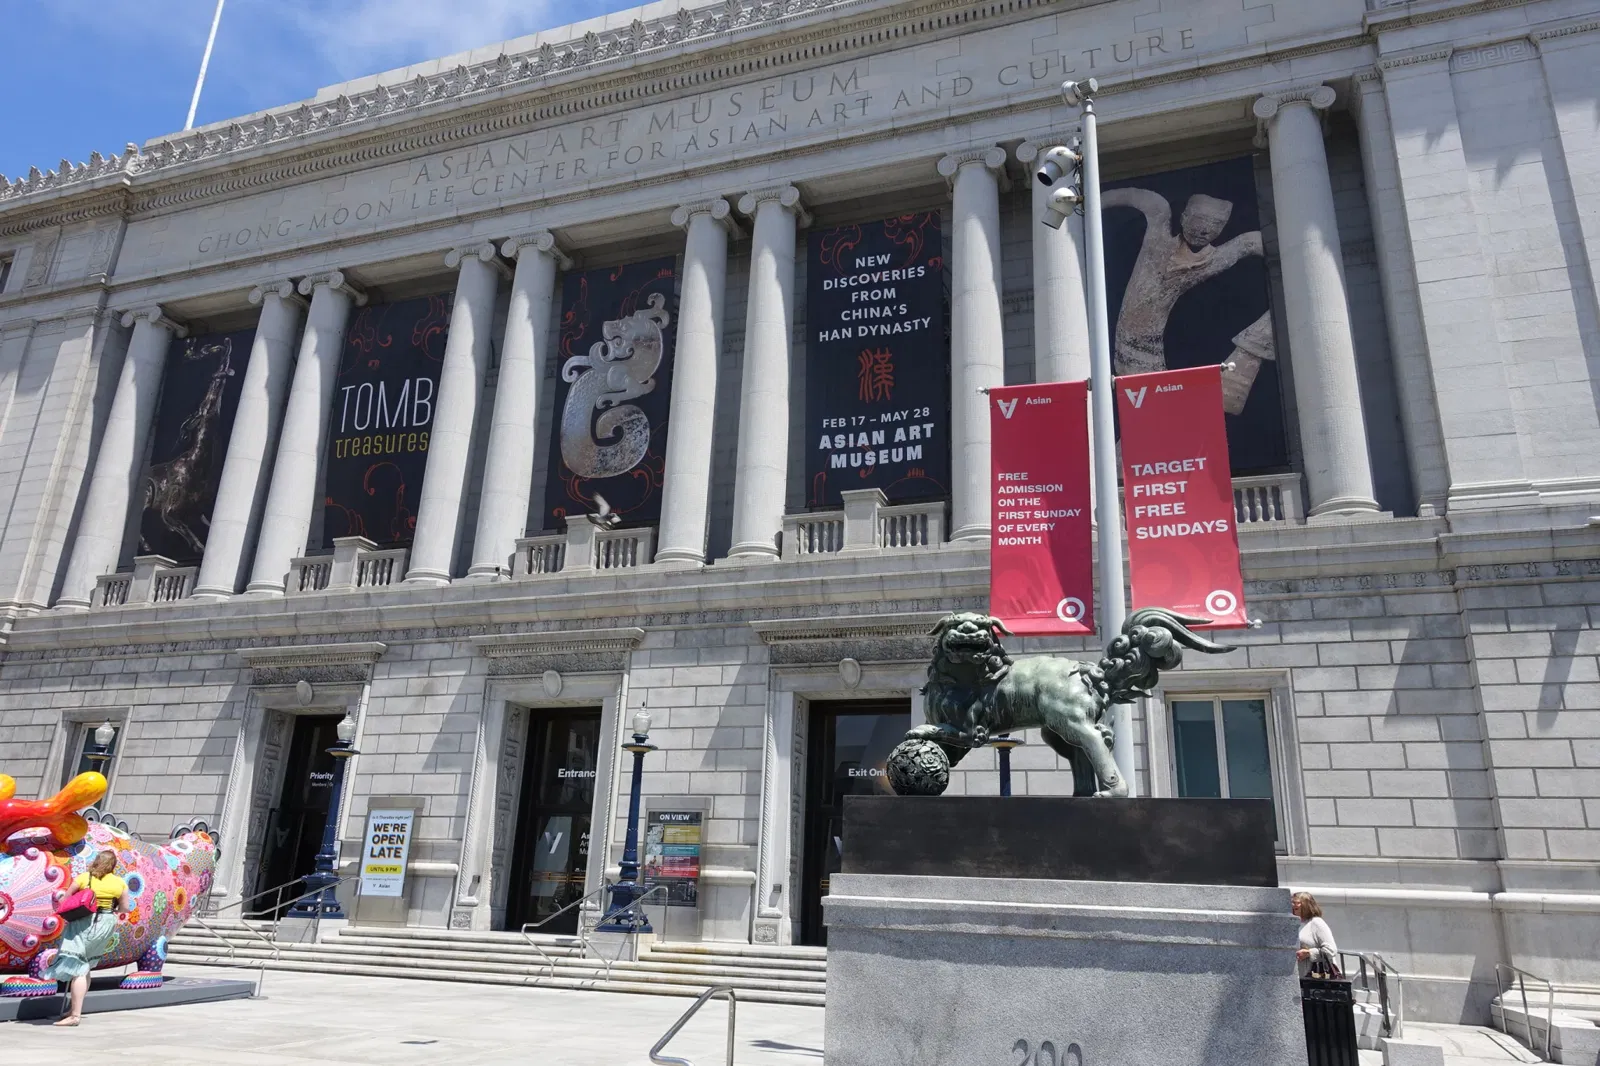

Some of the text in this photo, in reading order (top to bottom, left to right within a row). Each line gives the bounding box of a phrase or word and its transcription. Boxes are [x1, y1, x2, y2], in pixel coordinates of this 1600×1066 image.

[414, 67, 862, 185] ASIAN ART MUSEUM
[198, 28, 1195, 253] CHONG-MOON LEE CENTER FOR ASIAN ART AND CULTURE
[855, 253, 891, 269] NEW
[823, 265, 926, 291] DISCOVERIES
[851, 287, 896, 303] FROM
[841, 304, 908, 322] CHINA'S
[819, 317, 931, 343] HAN DYNASTY
[1155, 383, 1184, 394] Asian
[341, 377, 433, 433] TOMB
[1025, 396, 1052, 405] Asian
[823, 417, 847, 428] FEB
[851, 416, 866, 426] 17
[881, 410, 909, 423] MAY
[913, 407, 930, 418] 28
[819, 423, 935, 450] ASIAN ART
[336, 431, 429, 459] treasures
[831, 445, 923, 469] MUSEUM
[1131, 457, 1207, 477] TARGET
[998, 472, 1028, 481] FREE
[998, 484, 1063, 494] ADMISSION
[1133, 480, 1188, 498] FIRST
[998, 497, 1041, 507] ON THE
[998, 508, 1082, 520] FIRST SUNDAY
[1134, 502, 1186, 519] FREE
[998, 523, 1056, 533] OF EVERY
[1135, 519, 1229, 540] SUNDAYS
[998, 536, 1042, 546] MONTH
[310, 772, 334, 780] Priority
[557, 768, 597, 778] Entranc
[848, 768, 867, 777] Exit
[373, 823, 408, 833] WE'RE
[371, 834, 405, 845] OPEN
[370, 847, 403, 859] LATE
